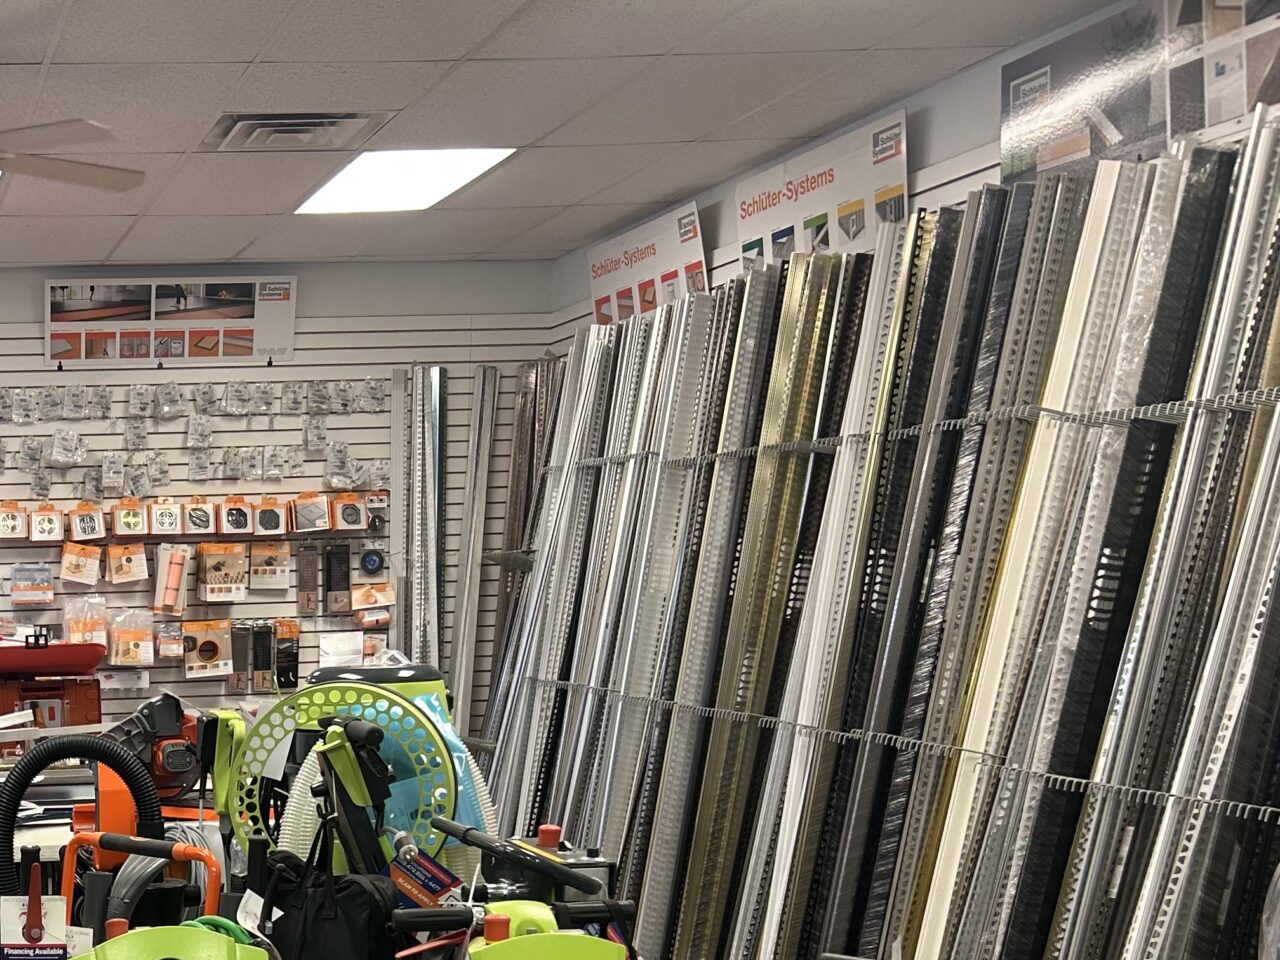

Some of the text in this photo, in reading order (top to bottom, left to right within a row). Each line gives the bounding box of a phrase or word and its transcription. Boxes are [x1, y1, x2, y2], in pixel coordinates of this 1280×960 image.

[740, 167, 835, 220] Schlüter-Systems
[591, 243, 657, 280] Schlüter-Systems
[4, 948, 34, 957] Financing
